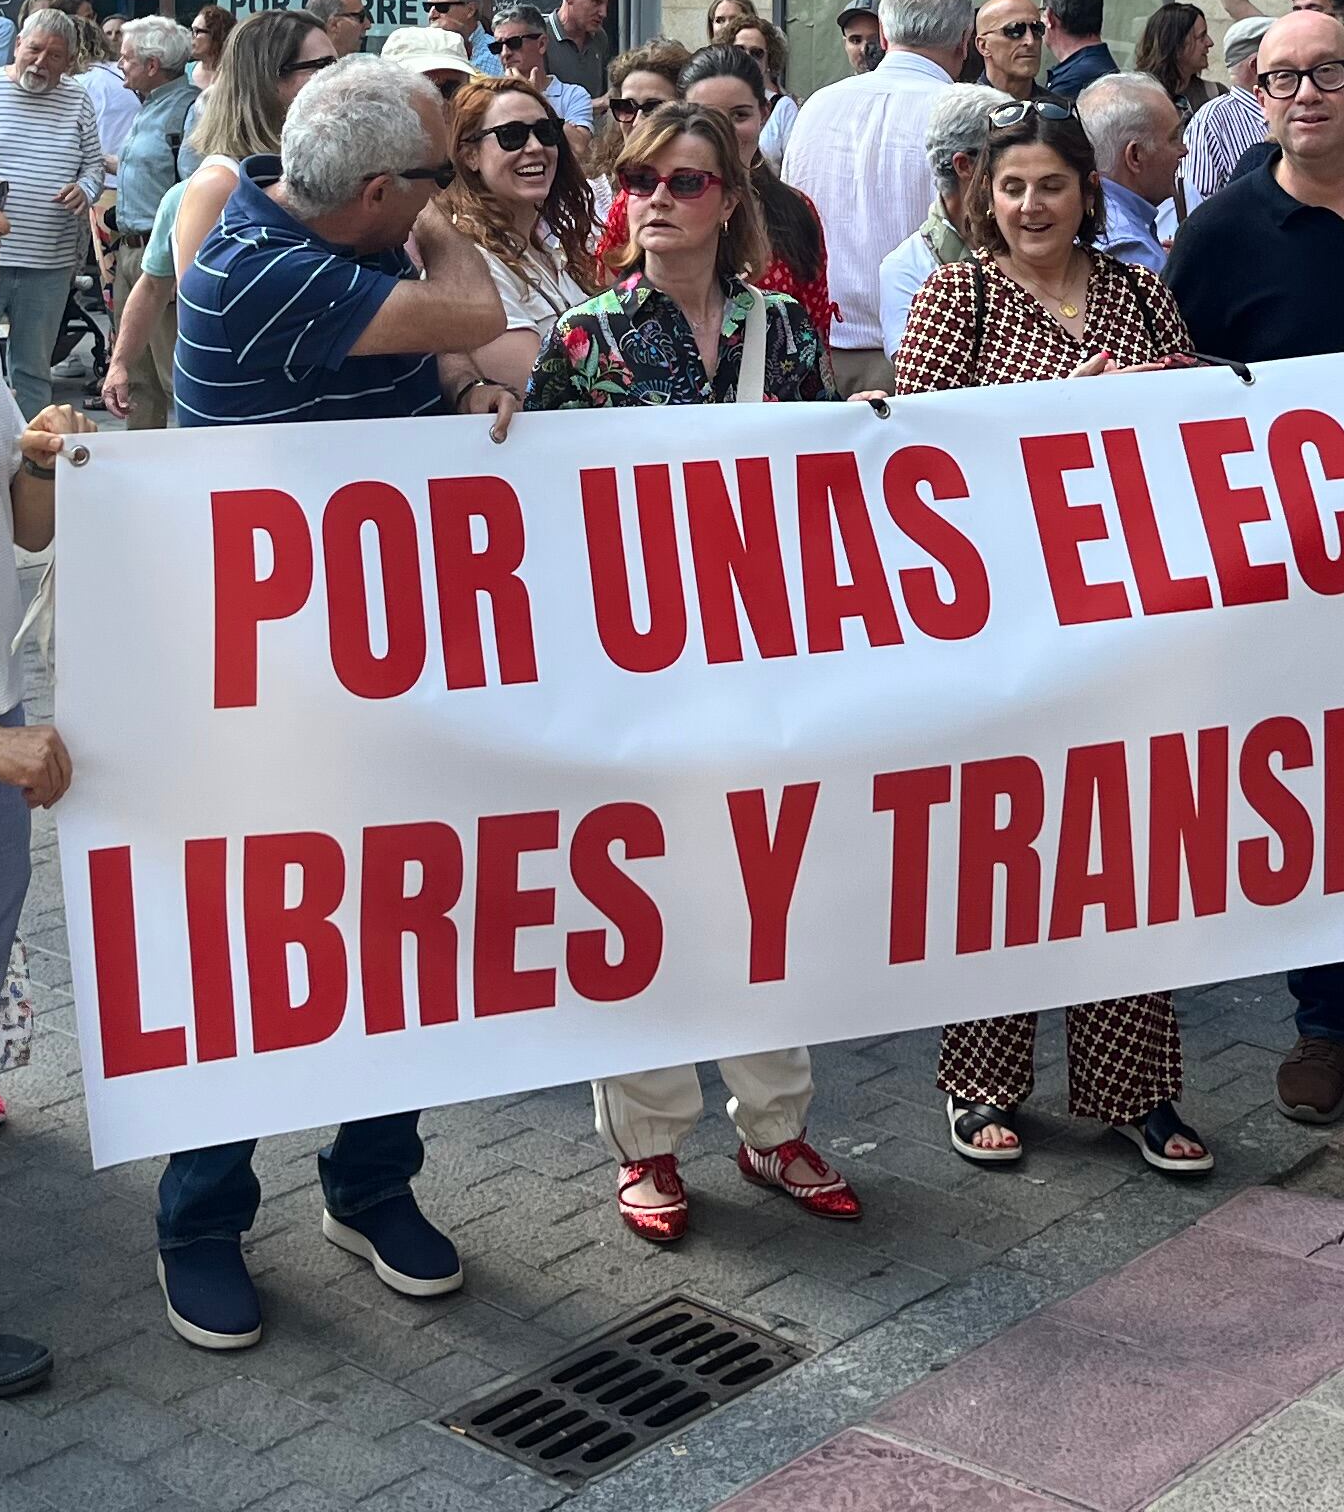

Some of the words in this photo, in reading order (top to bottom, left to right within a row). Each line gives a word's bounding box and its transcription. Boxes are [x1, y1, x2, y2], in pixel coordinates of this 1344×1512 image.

[212, 477, 537, 708] POR
[581, 446, 990, 672] UNAS
[90, 804, 664, 1077] LIBRES
[729, 784, 818, 982] Y
